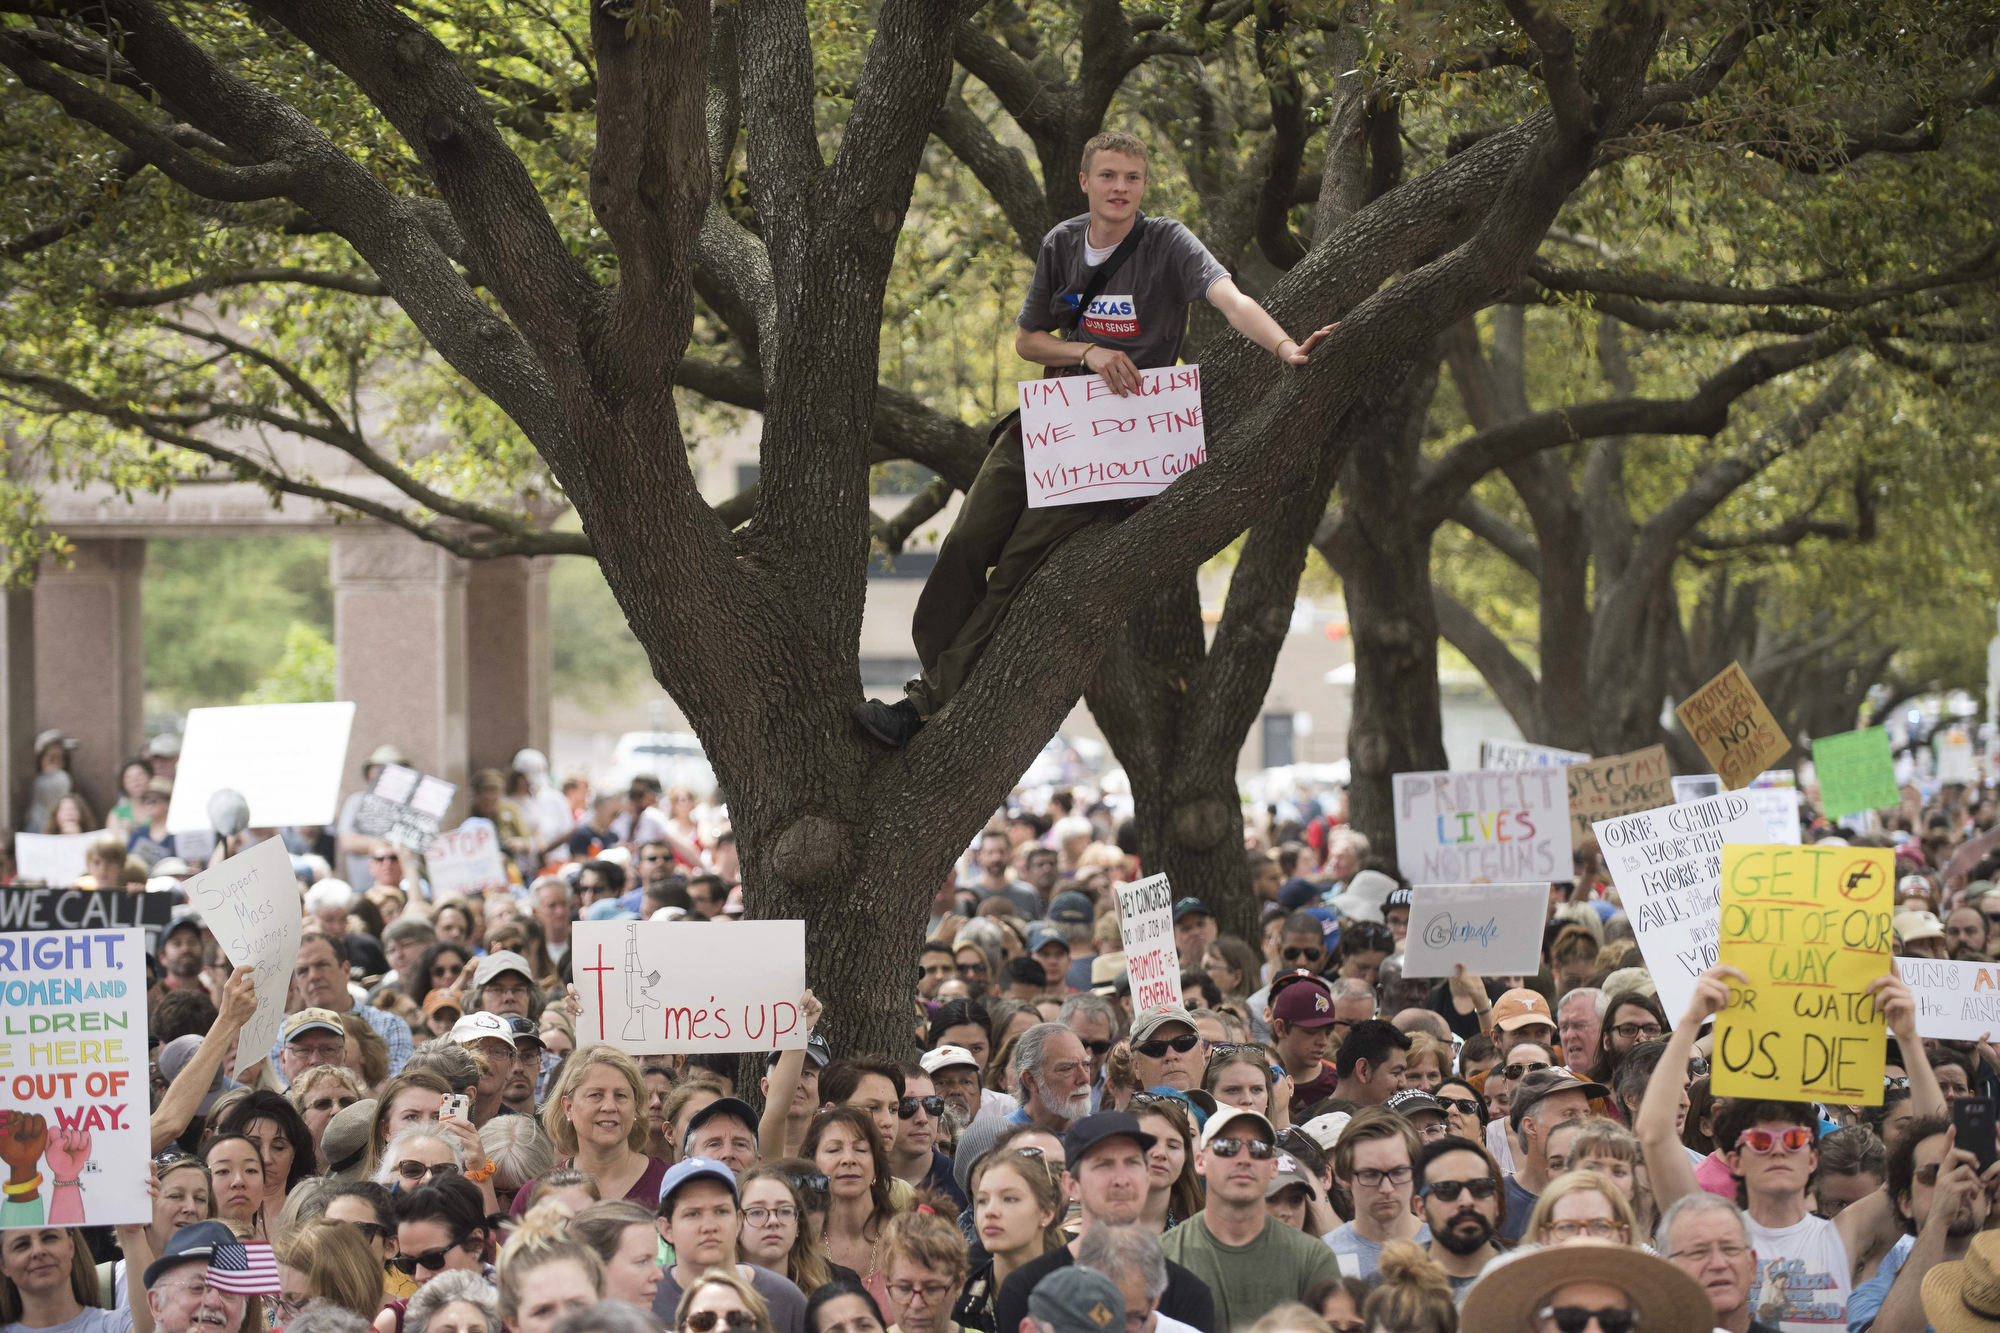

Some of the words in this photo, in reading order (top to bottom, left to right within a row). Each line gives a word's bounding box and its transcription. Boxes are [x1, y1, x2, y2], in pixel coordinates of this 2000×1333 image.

[1086, 301, 1132, 316] EXAS
[1105, 322, 1136, 333] SENSE
[1023, 380, 1070, 409] I'M
[1025, 422, 1076, 450] WE
[1091, 418, 1138, 437] DO
[1147, 405, 1204, 434] FINE
[1033, 455, 1159, 490] WITHOUT
[1682, 667, 1745, 727] PROTECT
[1695, 687, 1757, 746] CHILDREN
[1719, 711, 1757, 751] NOT
[1634, 753, 1663, 779] MY
[1719, 722, 1776, 780] GUNS
[1401, 769, 1559, 820] PROTECT
[1437, 809, 1536, 845] LIVES
[1604, 815, 1659, 849] ONE
[1668, 794, 1749, 834] CHILD
[1480, 841, 1555, 880] GUNS
[1621, 855, 1641, 873] is
[1641, 829, 1725, 866] WORTH
[196, 865, 259, 911] Support
[1640, 860, 1704, 897] MORE
[1731, 850, 1836, 899] GET
[55, 890, 162, 932] CALL
[233, 899, 274, 930] Mass
[1121, 889, 1136, 920] HEY
[1135, 878, 1172, 915] CONGRESS
[1638, 896, 1691, 933] ALL
[231, 925, 288, 961] Shootings
[1148, 919, 1160, 938] JOB
[1160, 915, 1171, 934] AND
[1722, 904, 1794, 943] OUT
[1801, 909, 1840, 943] OF
[1841, 909, 1892, 953] OUR
[1768, 947, 1836, 984] WAY
[84, 979, 127, 999] AND
[1138, 977, 1177, 1011] GENERAL
[1728, 988, 1757, 1013] OR
[1794, 991, 1886, 1026] WATCH
[1918, 994, 1950, 1017] the
[242, 1008, 275, 1048] NRA
[29, 1039, 130, 1067] HERE.
[1801, 1033, 1869, 1093] DIE
[12, 1073, 78, 1101] OUT
[85, 1071, 130, 1098] OF
[53, 1103, 131, 1132] WAY.
